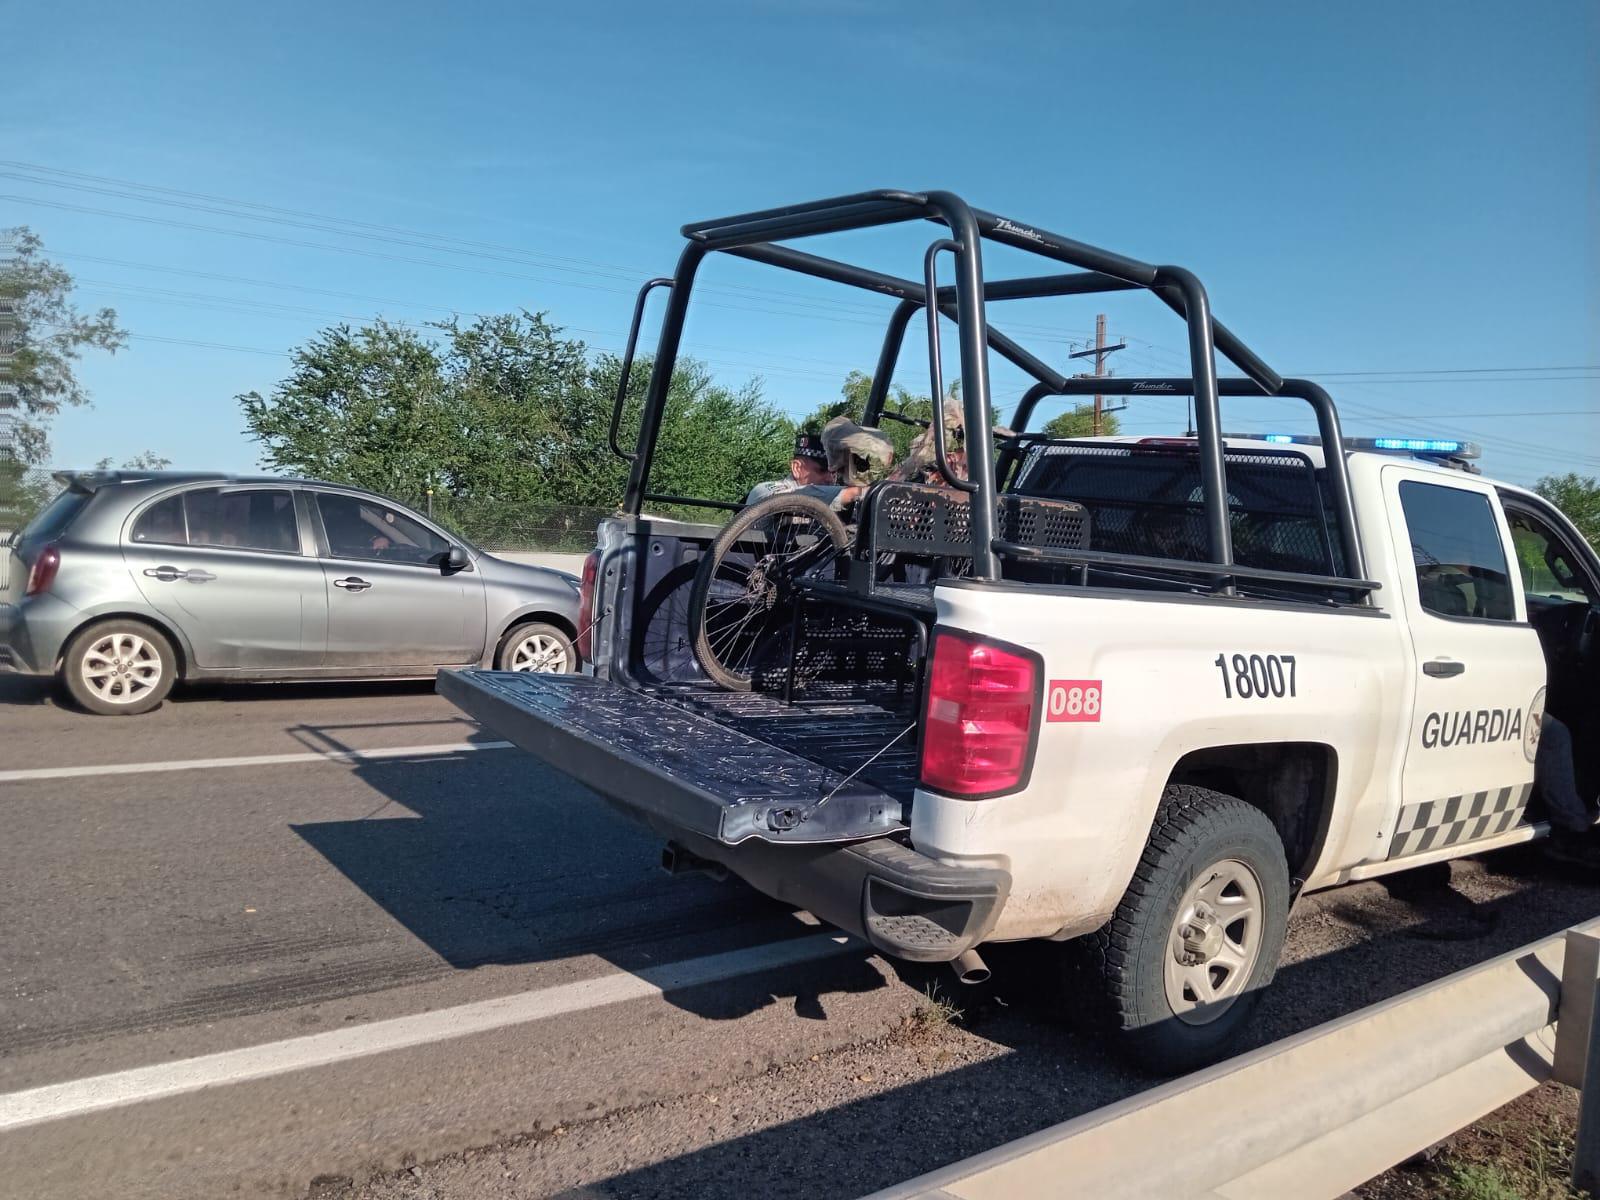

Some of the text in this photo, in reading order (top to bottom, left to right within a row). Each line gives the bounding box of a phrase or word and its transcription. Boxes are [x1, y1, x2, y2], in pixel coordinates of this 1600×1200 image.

[996, 217, 1042, 240] Thunder
[1132, 381, 1174, 390] Thunder
[1215, 653, 1296, 698] 18007
[1050, 687, 1100, 715] 088
[1422, 708, 1521, 749] GUARDIA
